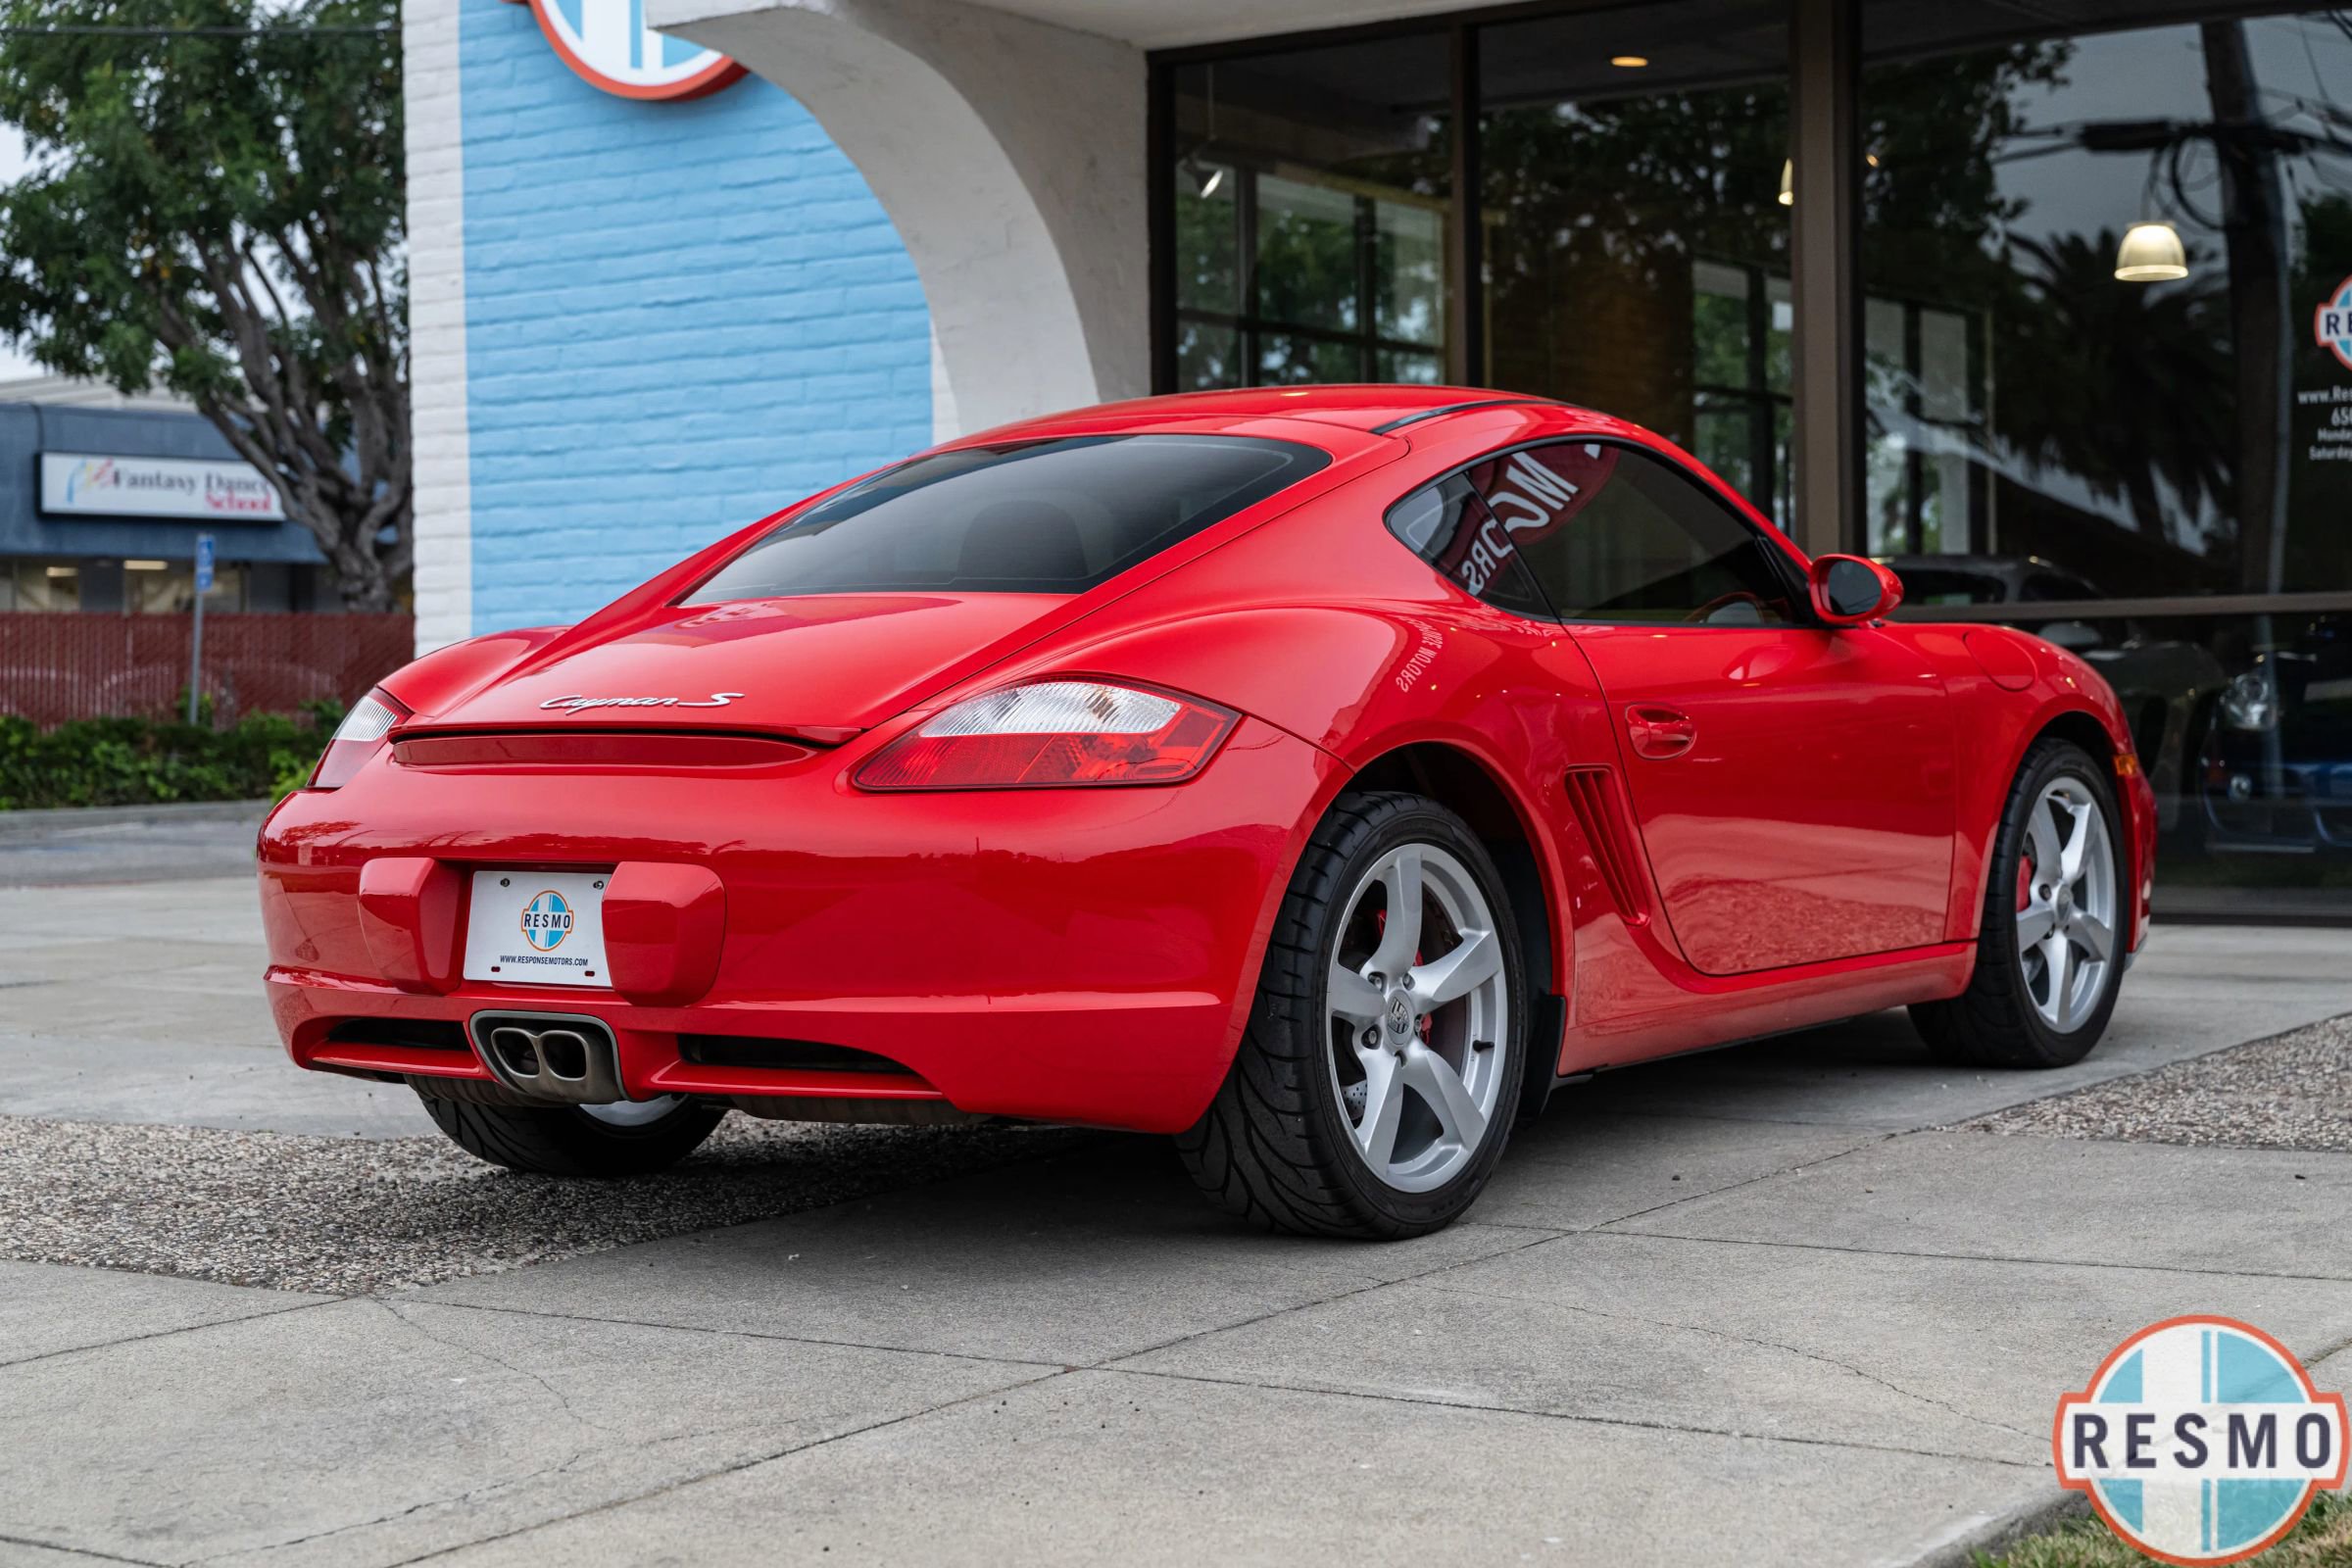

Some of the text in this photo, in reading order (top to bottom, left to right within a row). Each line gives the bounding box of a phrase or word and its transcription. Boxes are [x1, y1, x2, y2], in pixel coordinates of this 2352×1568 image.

[114, 468, 195, 495] Fantasy
[205, 489, 271, 512] School
[540, 693, 745, 715] Cayman S
[523, 913, 570, 929] RESMO
[500, 955, 588, 966] WWW.RESPONSEMOTORS.COM
